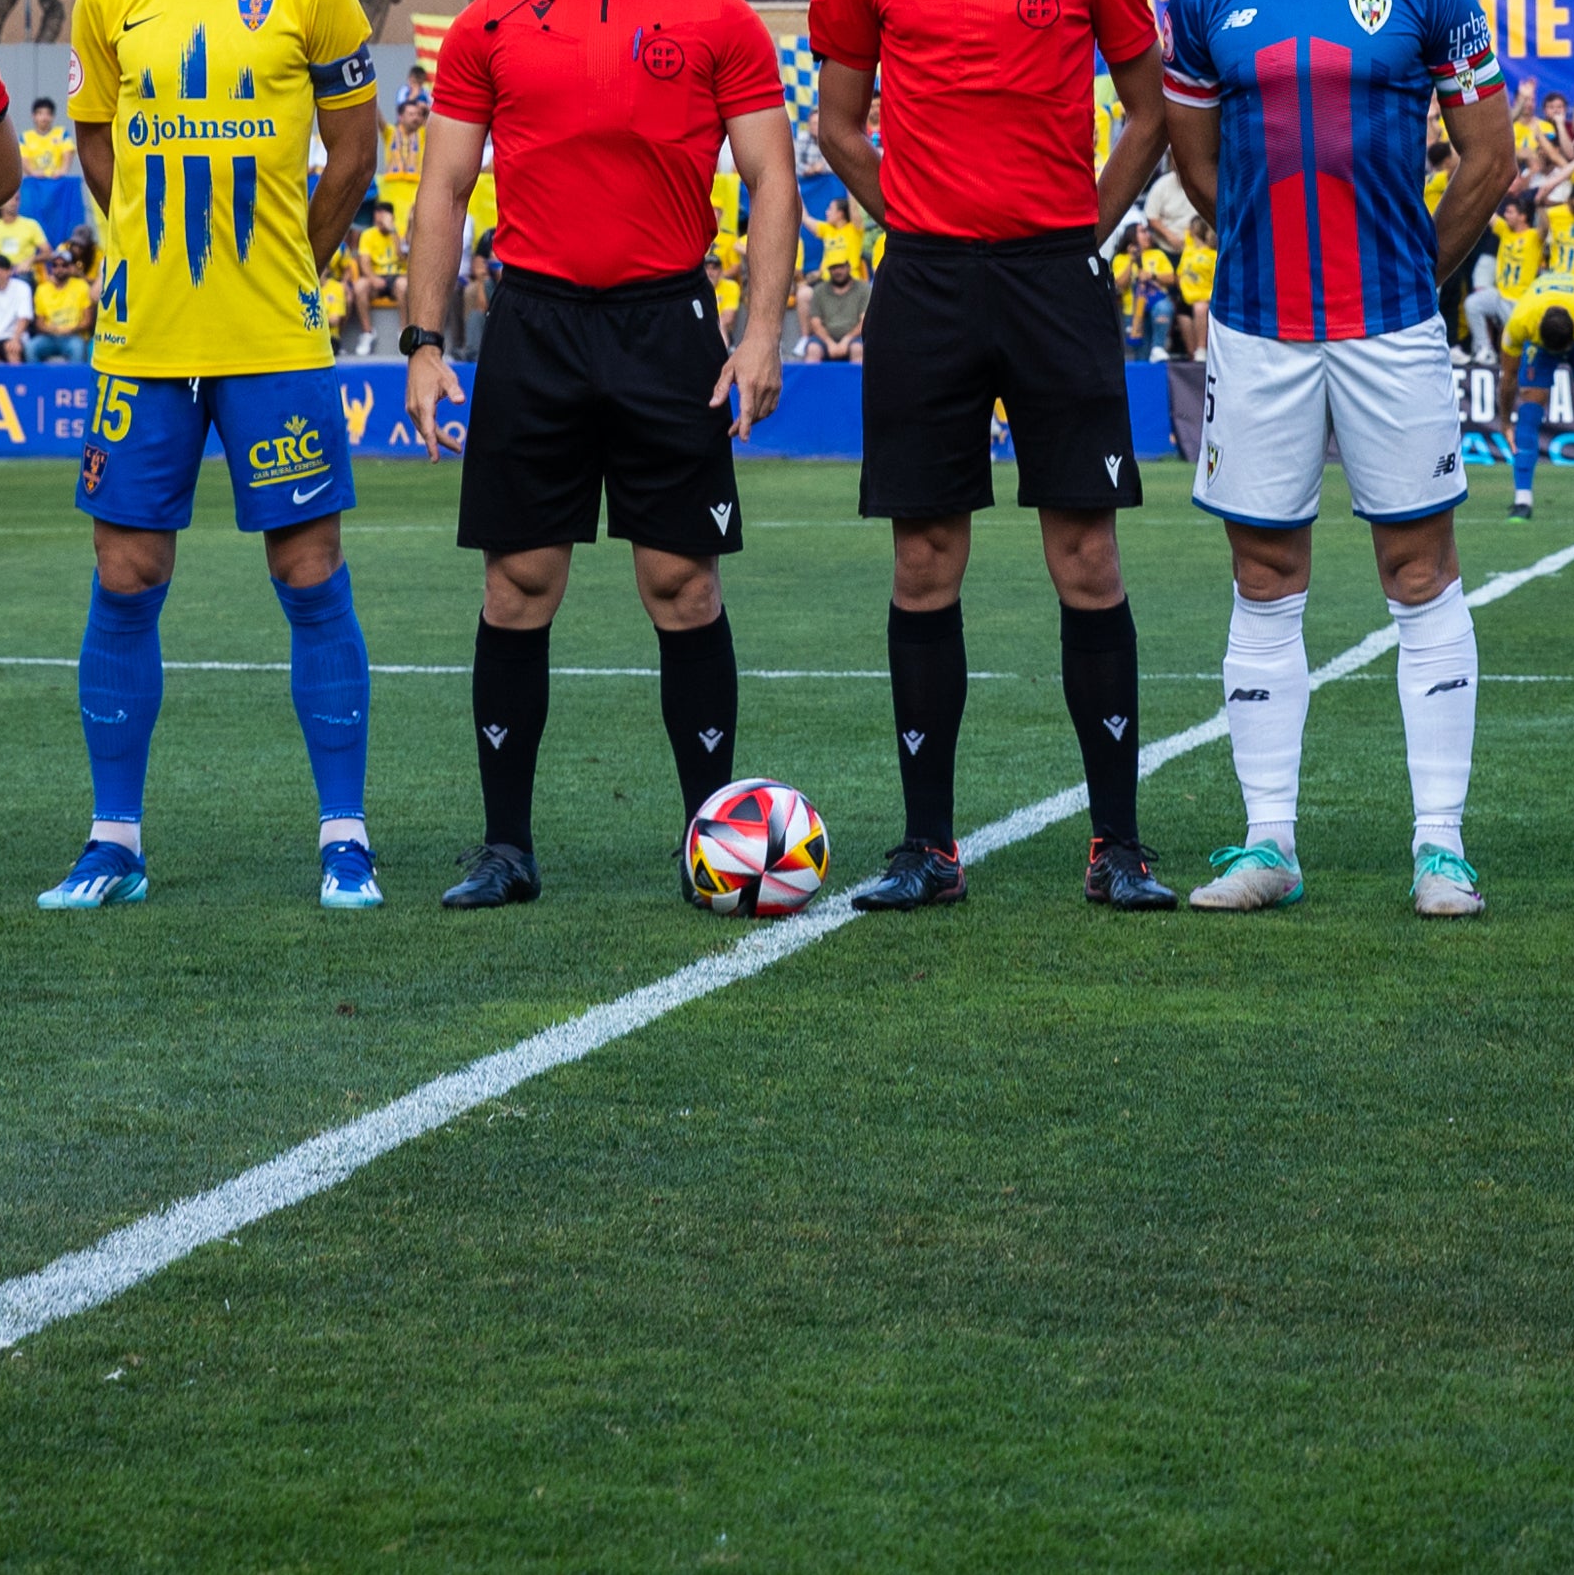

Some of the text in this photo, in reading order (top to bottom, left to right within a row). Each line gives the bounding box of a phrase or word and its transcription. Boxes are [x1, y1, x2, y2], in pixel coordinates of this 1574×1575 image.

[341, 57, 364, 88] C
[151, 114, 277, 146] johnson
[92, 375, 140, 442] 15
[249, 429, 323, 470] CRC
